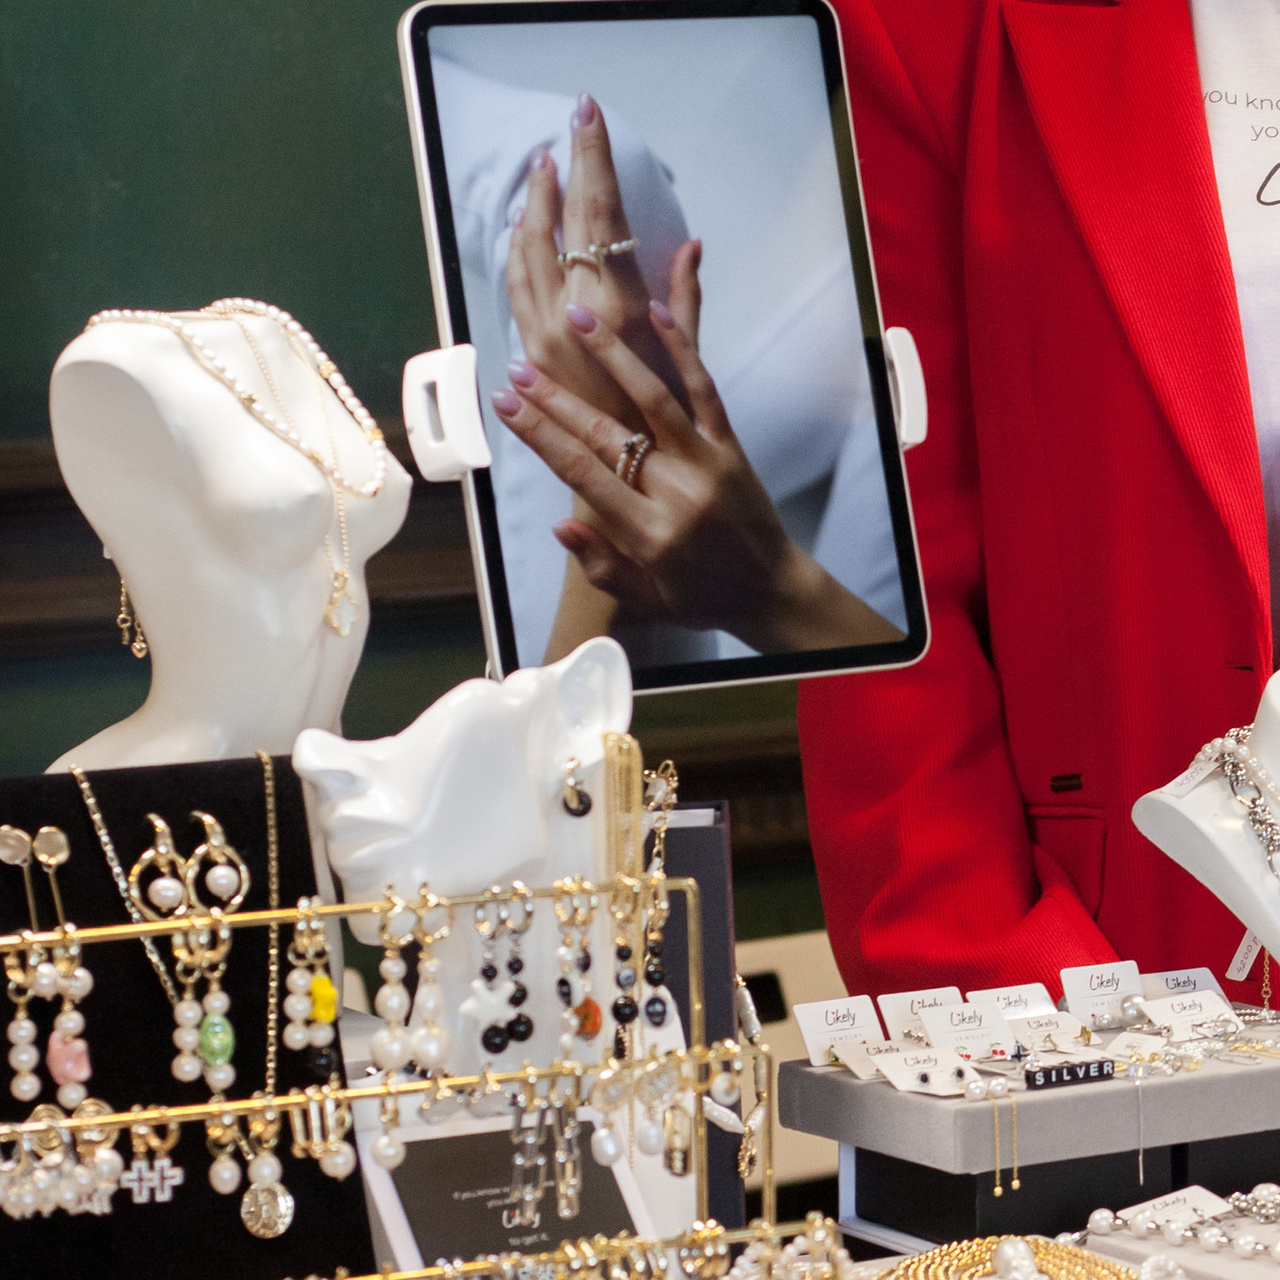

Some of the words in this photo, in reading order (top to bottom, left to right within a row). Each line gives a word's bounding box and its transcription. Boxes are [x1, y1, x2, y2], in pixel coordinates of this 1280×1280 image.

[1089, 972, 1120, 992] Likely
[1165, 975, 1197, 990] Likely
[1171, 1000, 1203, 1014] Likely
[825, 1007, 856, 1027] Likely
[950, 1010, 983, 1027] Likely
[904, 1055, 938, 1067] Likely
[1034, 1061, 1113, 1086] SILVER
